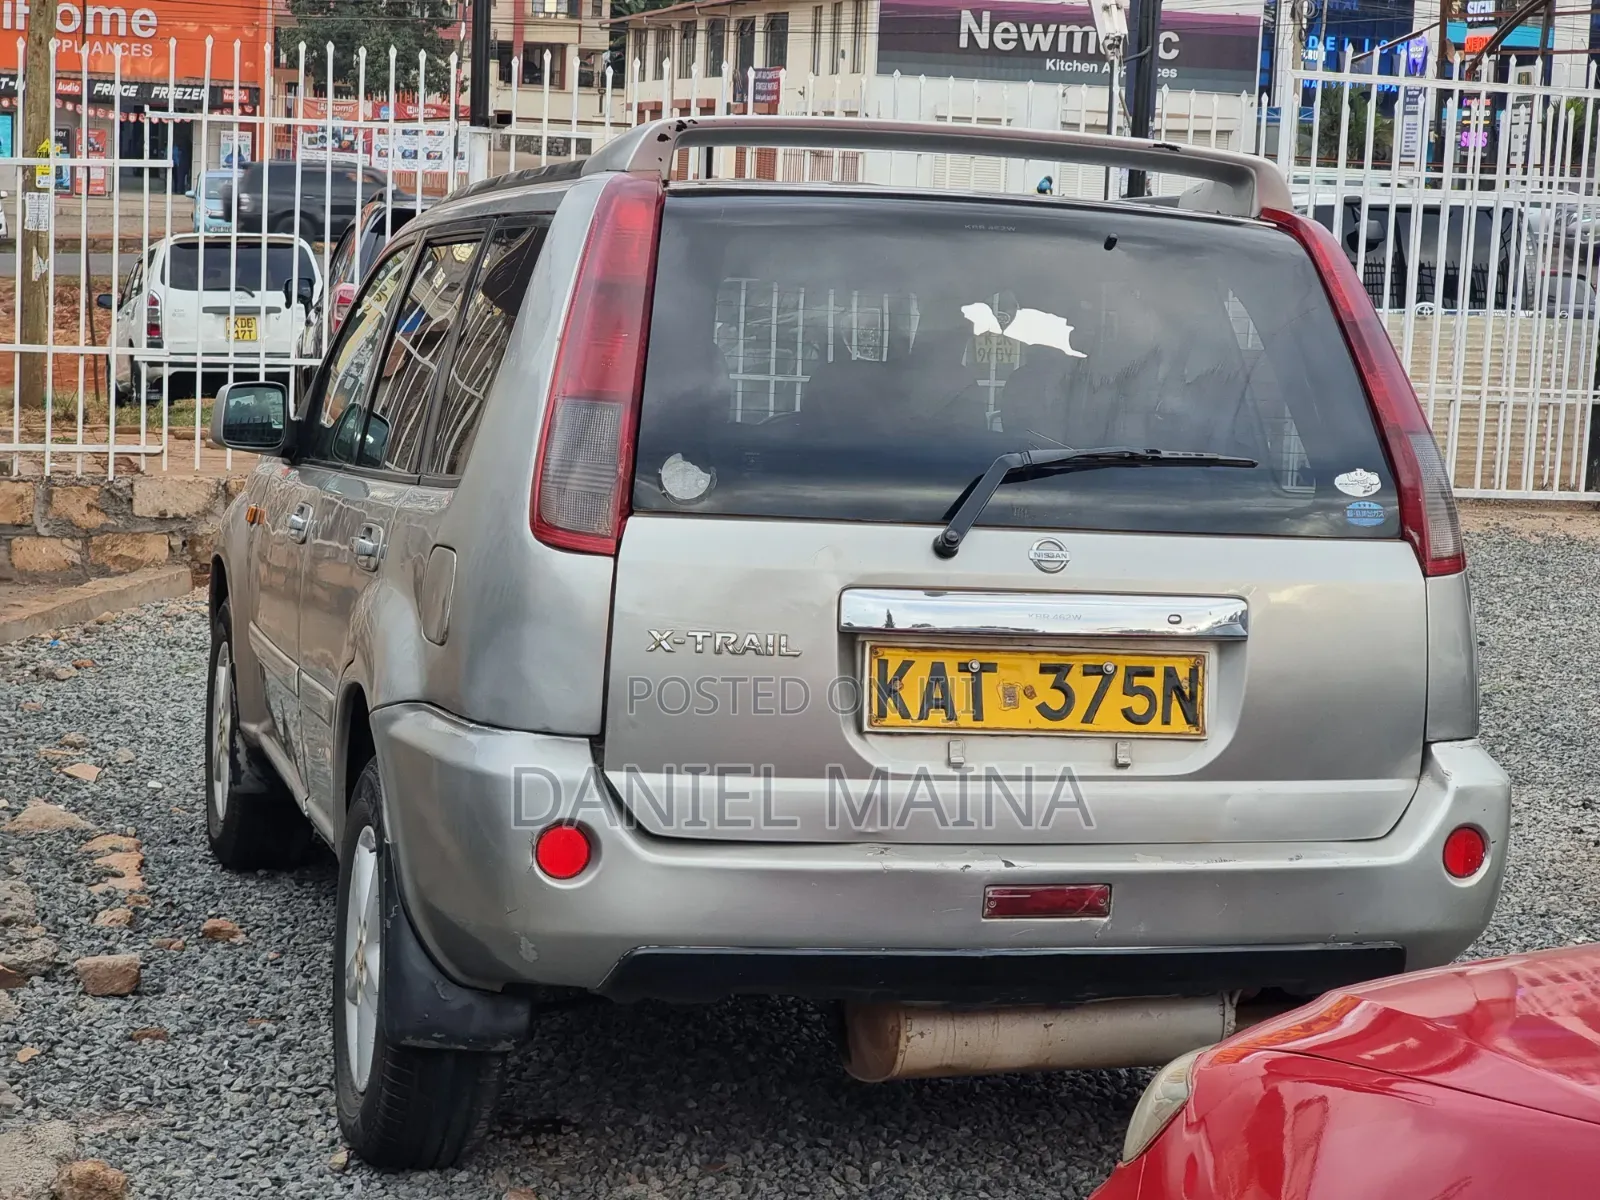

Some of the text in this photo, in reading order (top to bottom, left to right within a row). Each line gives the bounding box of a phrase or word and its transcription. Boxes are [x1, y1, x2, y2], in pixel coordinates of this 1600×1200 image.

[959, 9, 1180, 60] Newmc
[1046, 58, 1098, 74] Kitchen
[57, 81, 80, 92] Audio
[1378, 84, 1397, 92] SPA
[151, 86, 207, 101] FREZER
[227, 329, 253, 340] 17T
[1034, 551, 1068, 560] NISSAN
[1052, 613, 1082, 621] 462W
[646, 628, 803, 657] X-TRAIL
[876, 657, 1200, 727] KAT 375N
